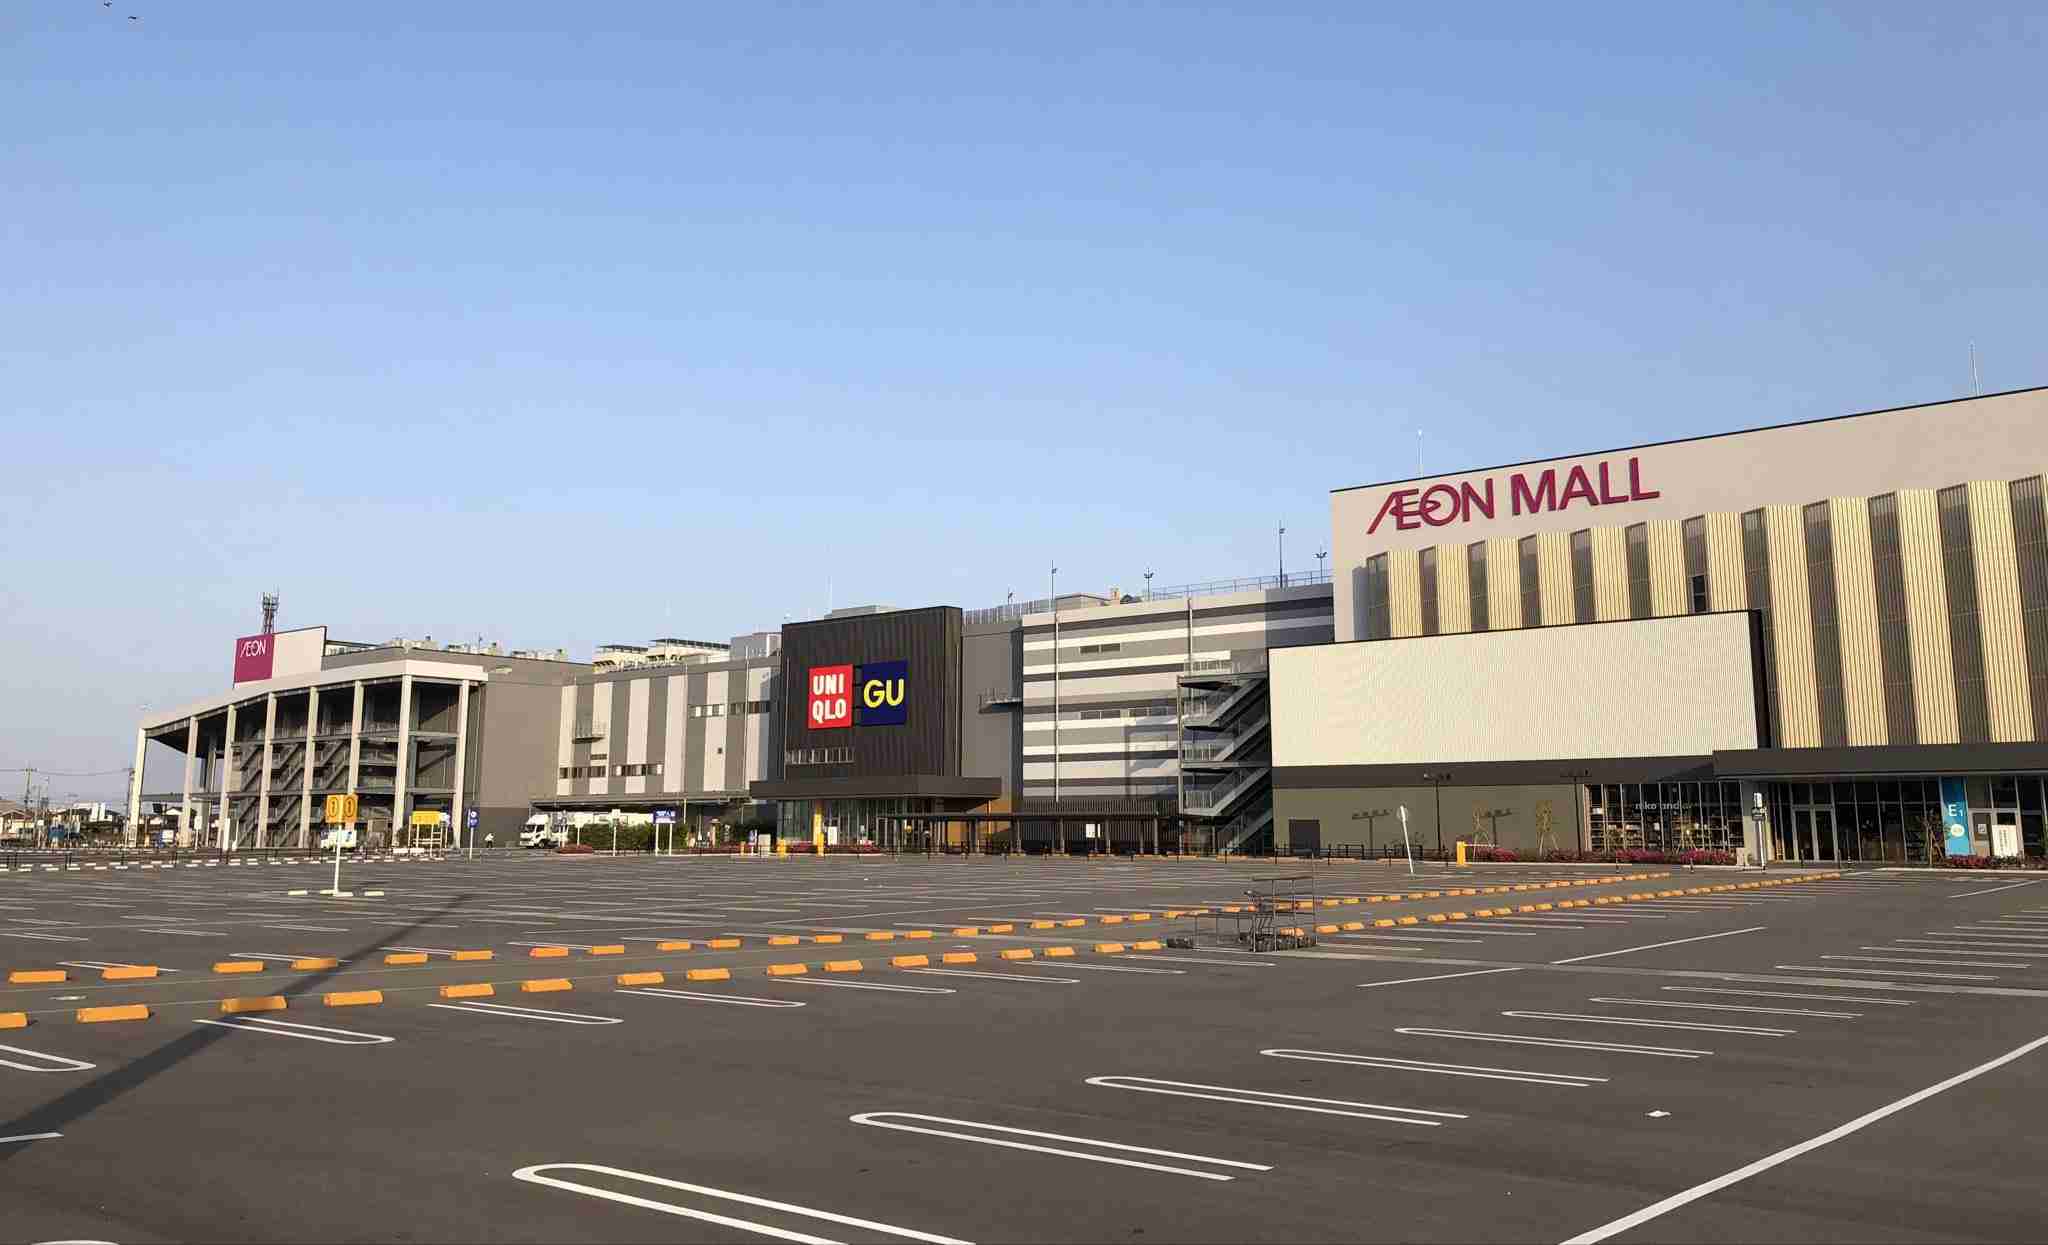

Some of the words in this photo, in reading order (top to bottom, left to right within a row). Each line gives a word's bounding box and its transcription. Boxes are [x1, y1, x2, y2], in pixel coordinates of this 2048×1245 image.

[1510, 457, 1660, 516] MALL
[813, 673, 844, 695] UNI
[863, 678, 905, 708] GU
[812, 698, 847, 723] QLO
